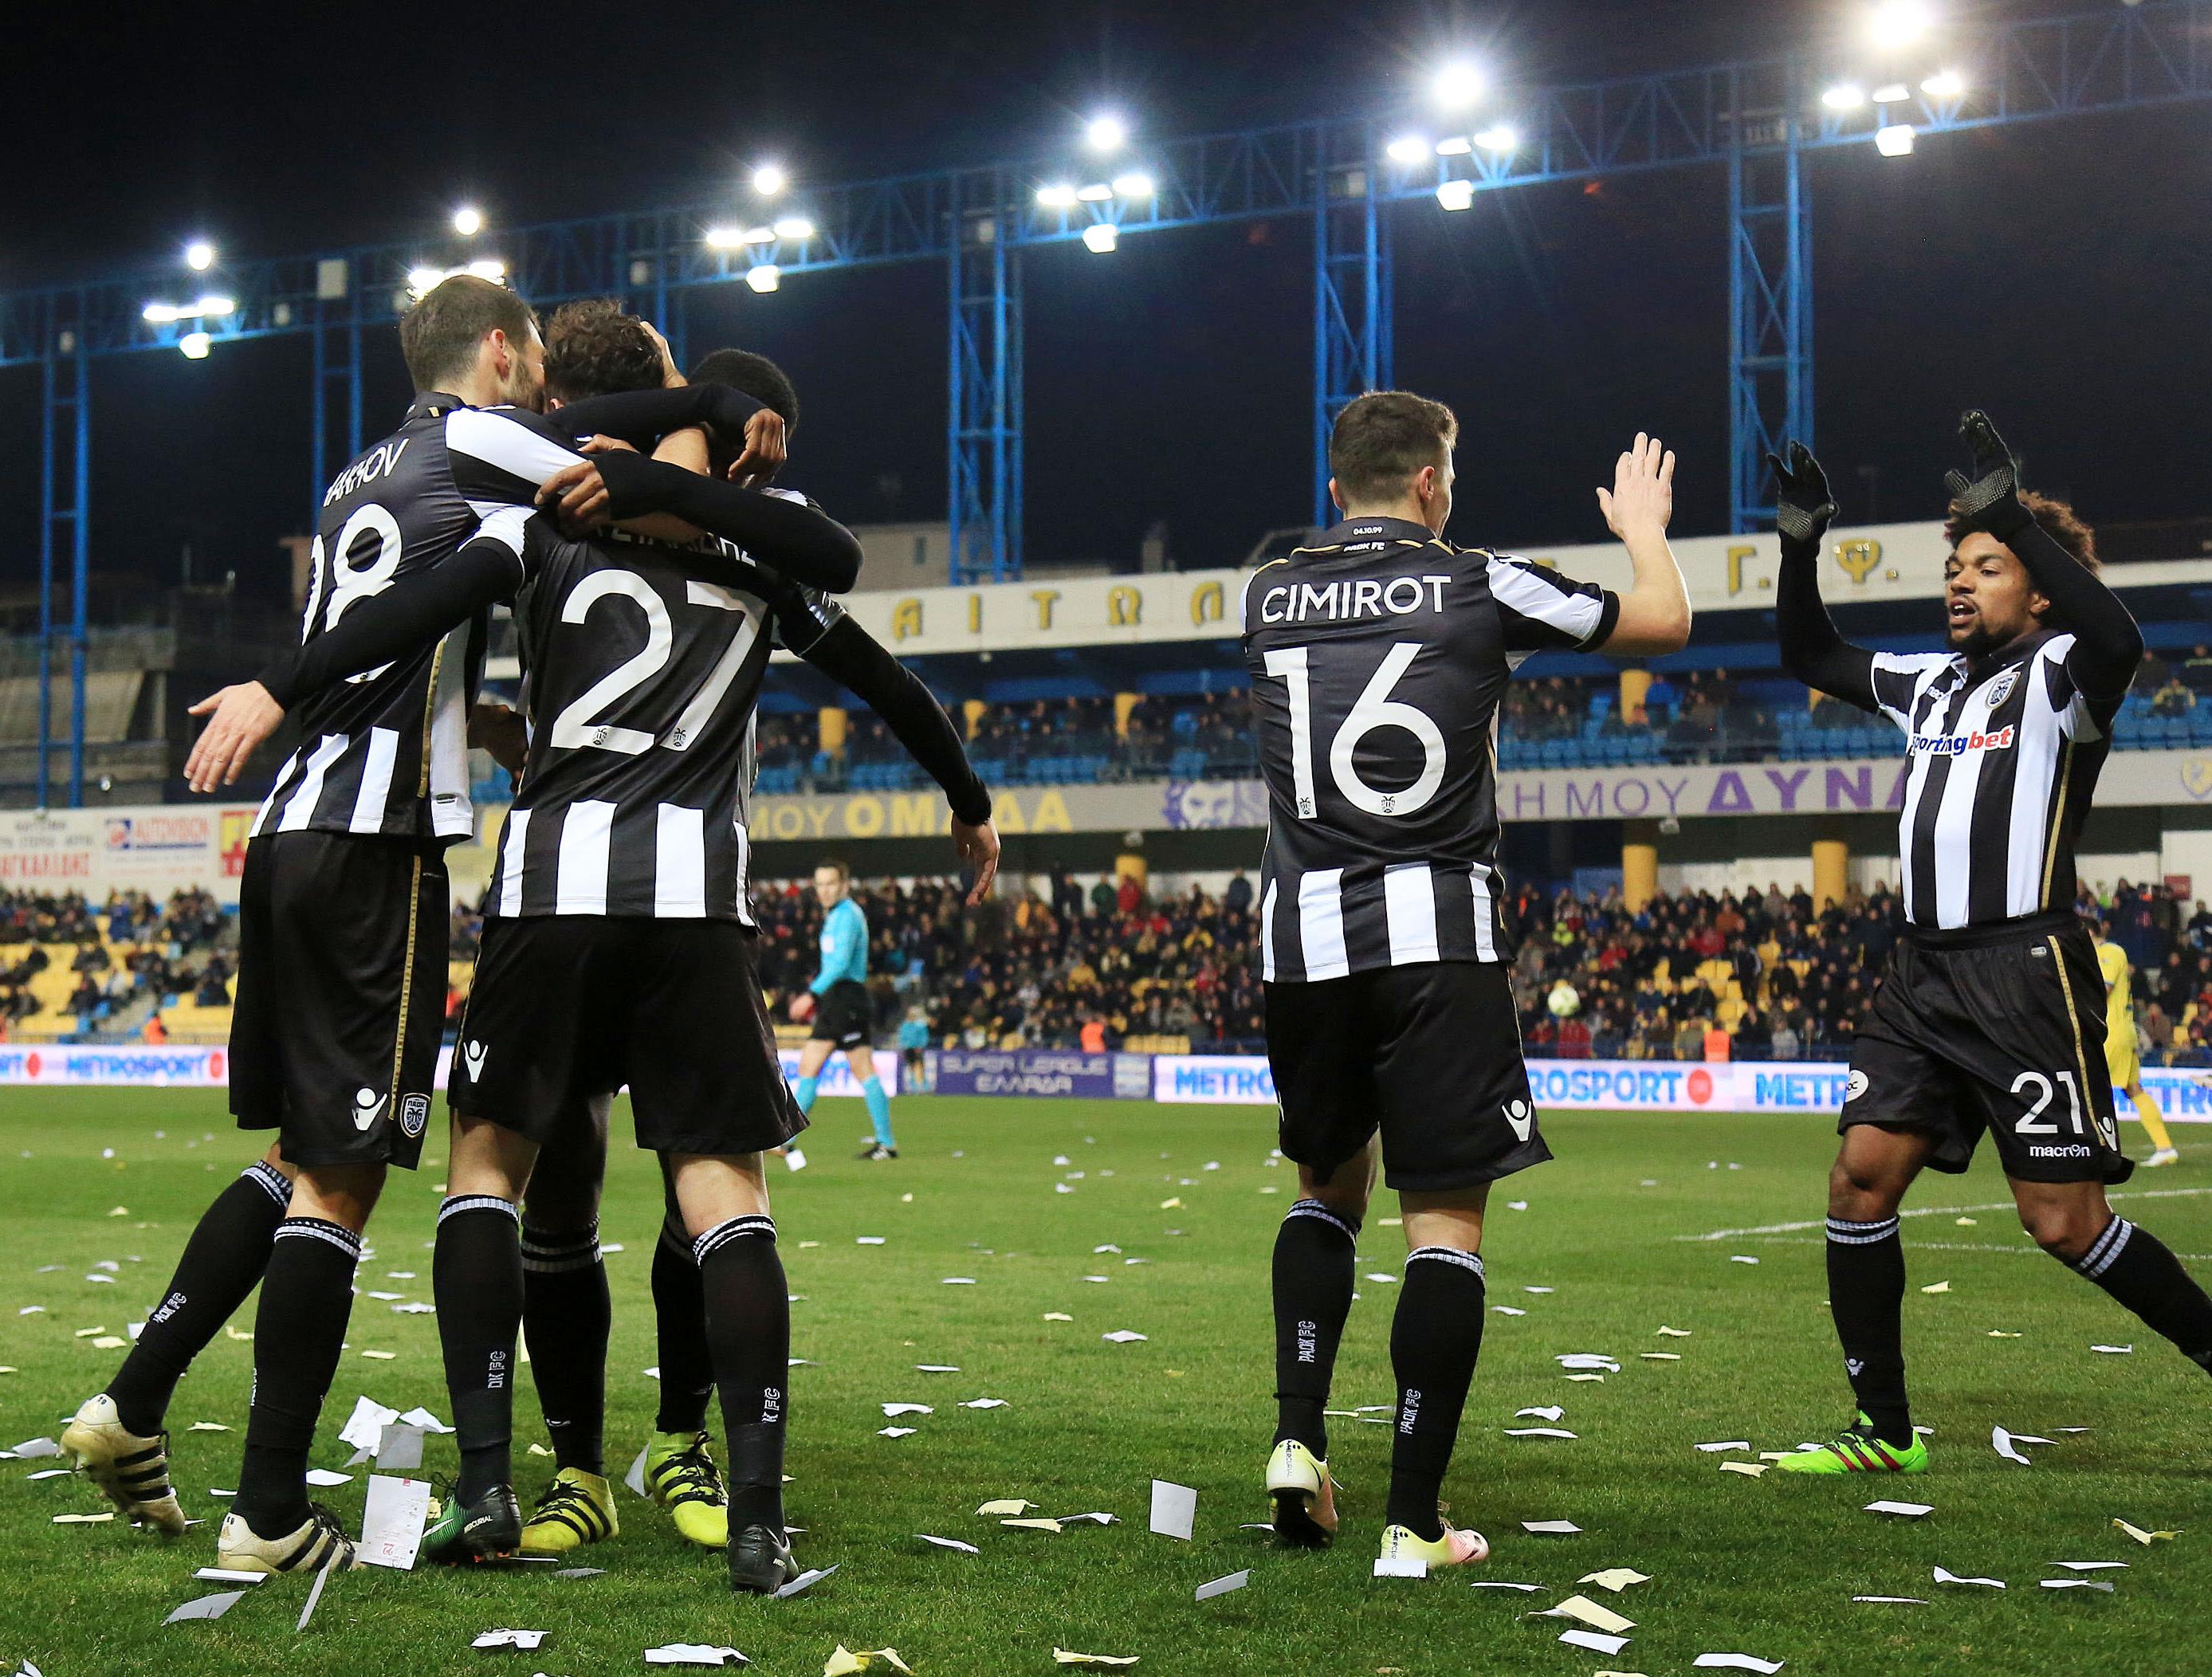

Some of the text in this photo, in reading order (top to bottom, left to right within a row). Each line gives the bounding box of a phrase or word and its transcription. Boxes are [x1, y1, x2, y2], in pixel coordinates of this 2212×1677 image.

[1353, 526, 1383, 535] 04.10.99
[1371, 541, 1385, 551] FC
[1262, 575, 1452, 622] CIMIROT
[550, 569, 768, 756] 27
[1263, 642, 1447, 820] 16
[844, 791, 1073, 838] ΟΜΔΑ
[1566, 778, 1689, 819] ΜΟΥ
[67, 1052, 206, 1078] METROSPORT
[2010, 1071, 2084, 1134] 21
[2029, 1145, 2091, 1157] macron
[167, 1292, 187, 1310] FC
[489, 1350, 506, 1371] FC
[1298, 1320, 1316, 1363] PAOK FC
[764, 1387, 780, 1411] FC
[1400, 1388, 1421, 1435] PAOK FC
